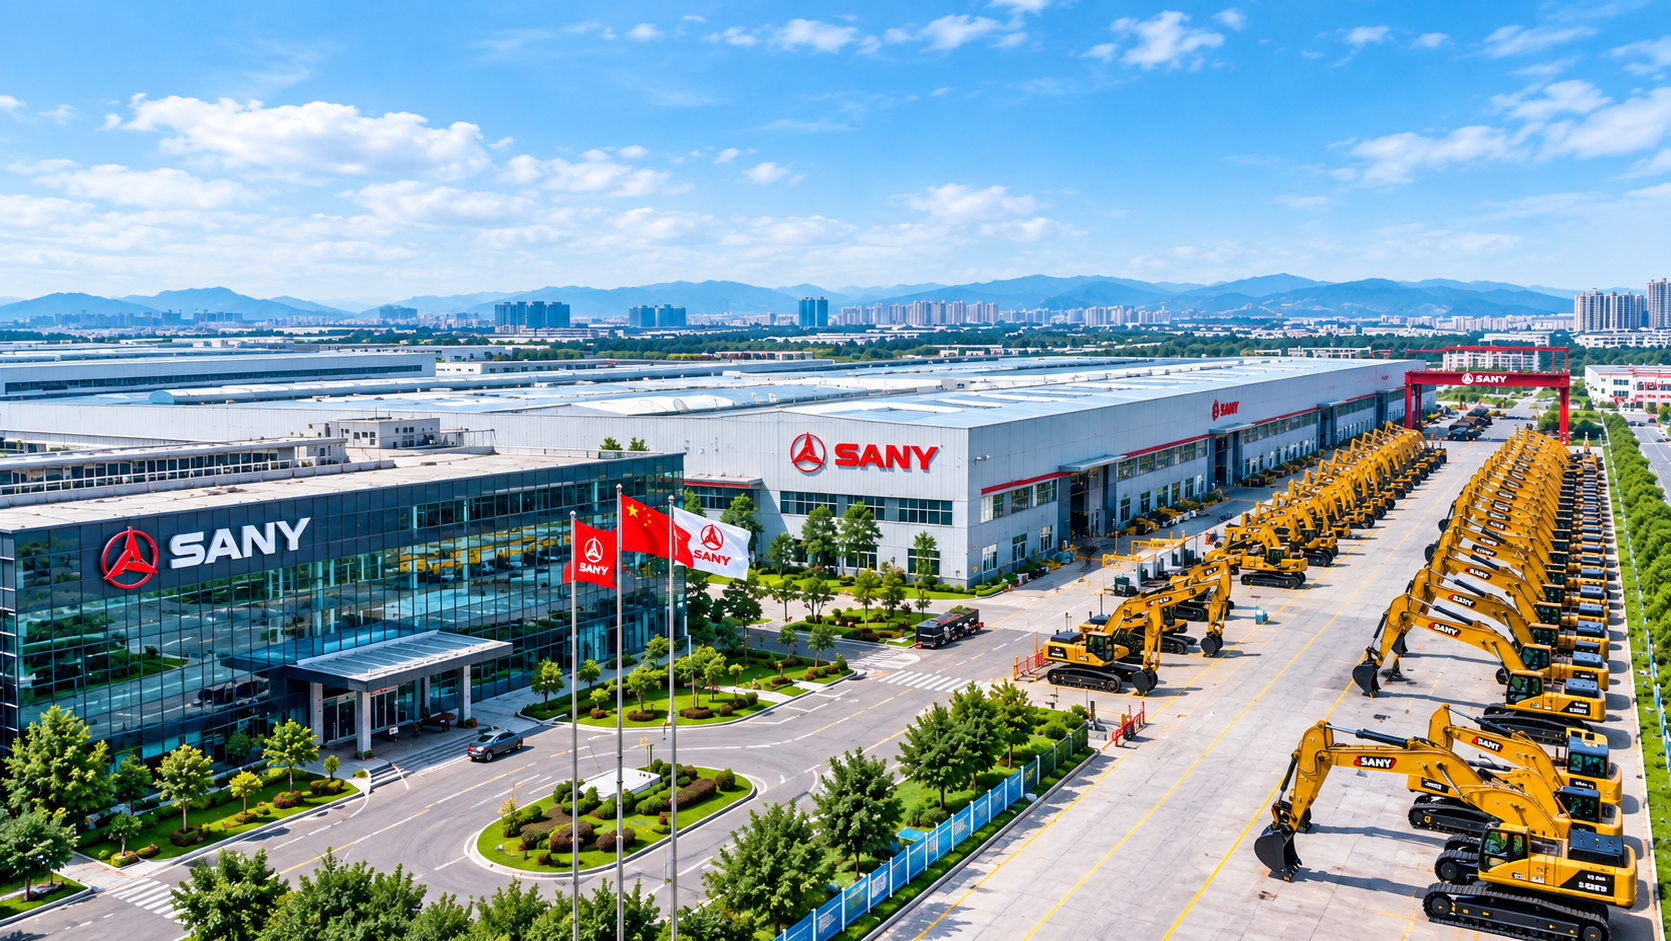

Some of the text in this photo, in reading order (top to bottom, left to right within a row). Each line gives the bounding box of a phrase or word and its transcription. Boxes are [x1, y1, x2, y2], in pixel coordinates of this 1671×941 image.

[1475, 375, 1507, 383] SANY
[834, 443, 938, 470] SANY
[169, 517, 311, 569] SANY
[693, 549, 731, 566] SANY
[579, 562, 609, 576] SANY
[1360, 756, 1392, 768] SANY
